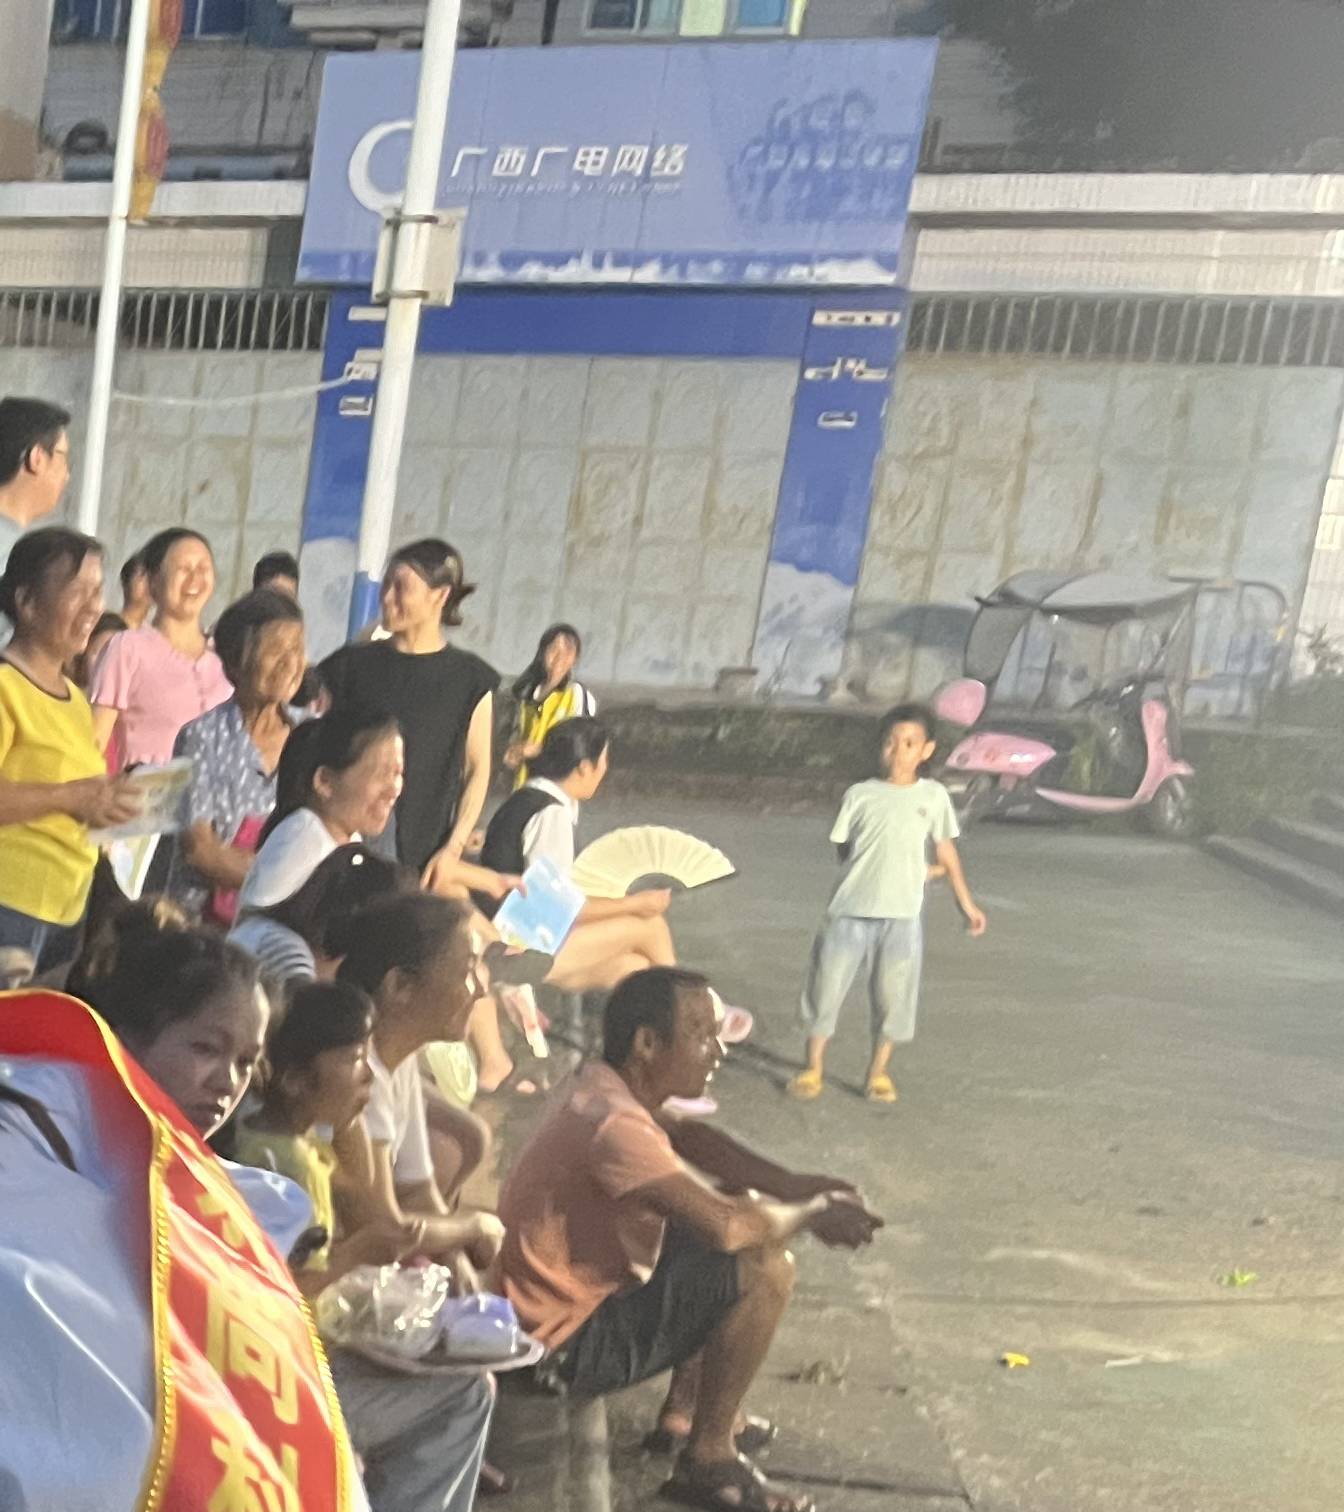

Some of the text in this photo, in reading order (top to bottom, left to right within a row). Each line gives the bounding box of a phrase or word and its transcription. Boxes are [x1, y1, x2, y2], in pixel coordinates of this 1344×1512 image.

[450, 144, 688, 177] 广西广电网络
